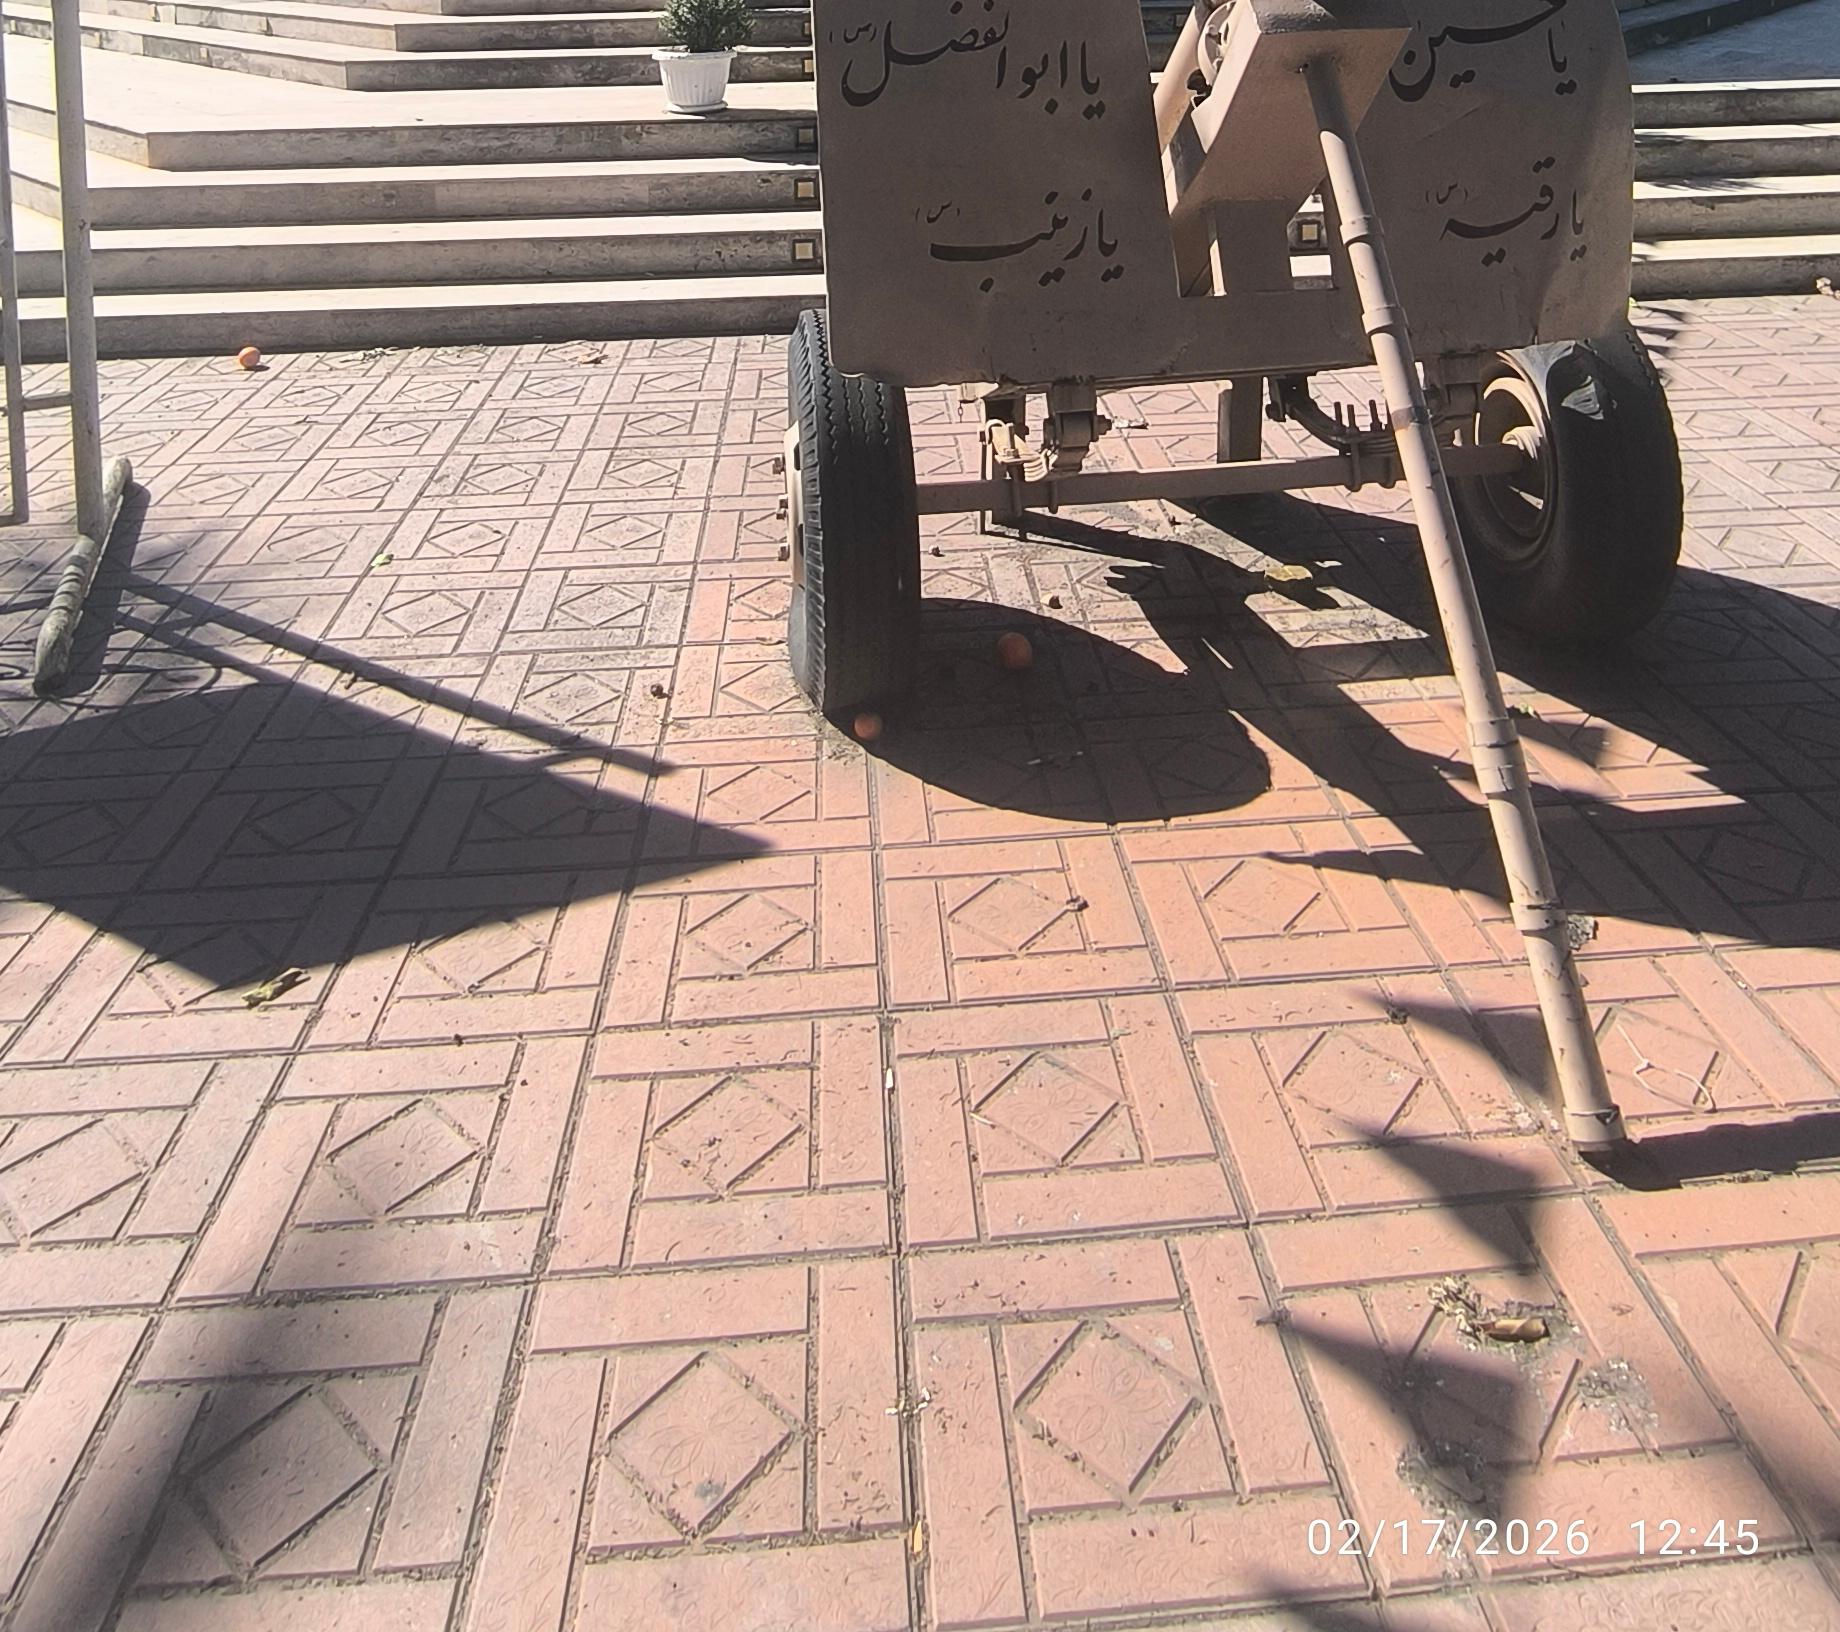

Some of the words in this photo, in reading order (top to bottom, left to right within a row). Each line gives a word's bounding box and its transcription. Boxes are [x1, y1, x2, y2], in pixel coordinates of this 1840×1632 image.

[1080, 41, 1106, 120] یا
[1547, 20, 1577, 95] یا
[929, 187, 1093, 293] زینب
[1098, 207, 1124, 283] یا
[1438, 156, 1560, 267] رقیه
[1569, 189, 1588, 261] یا
